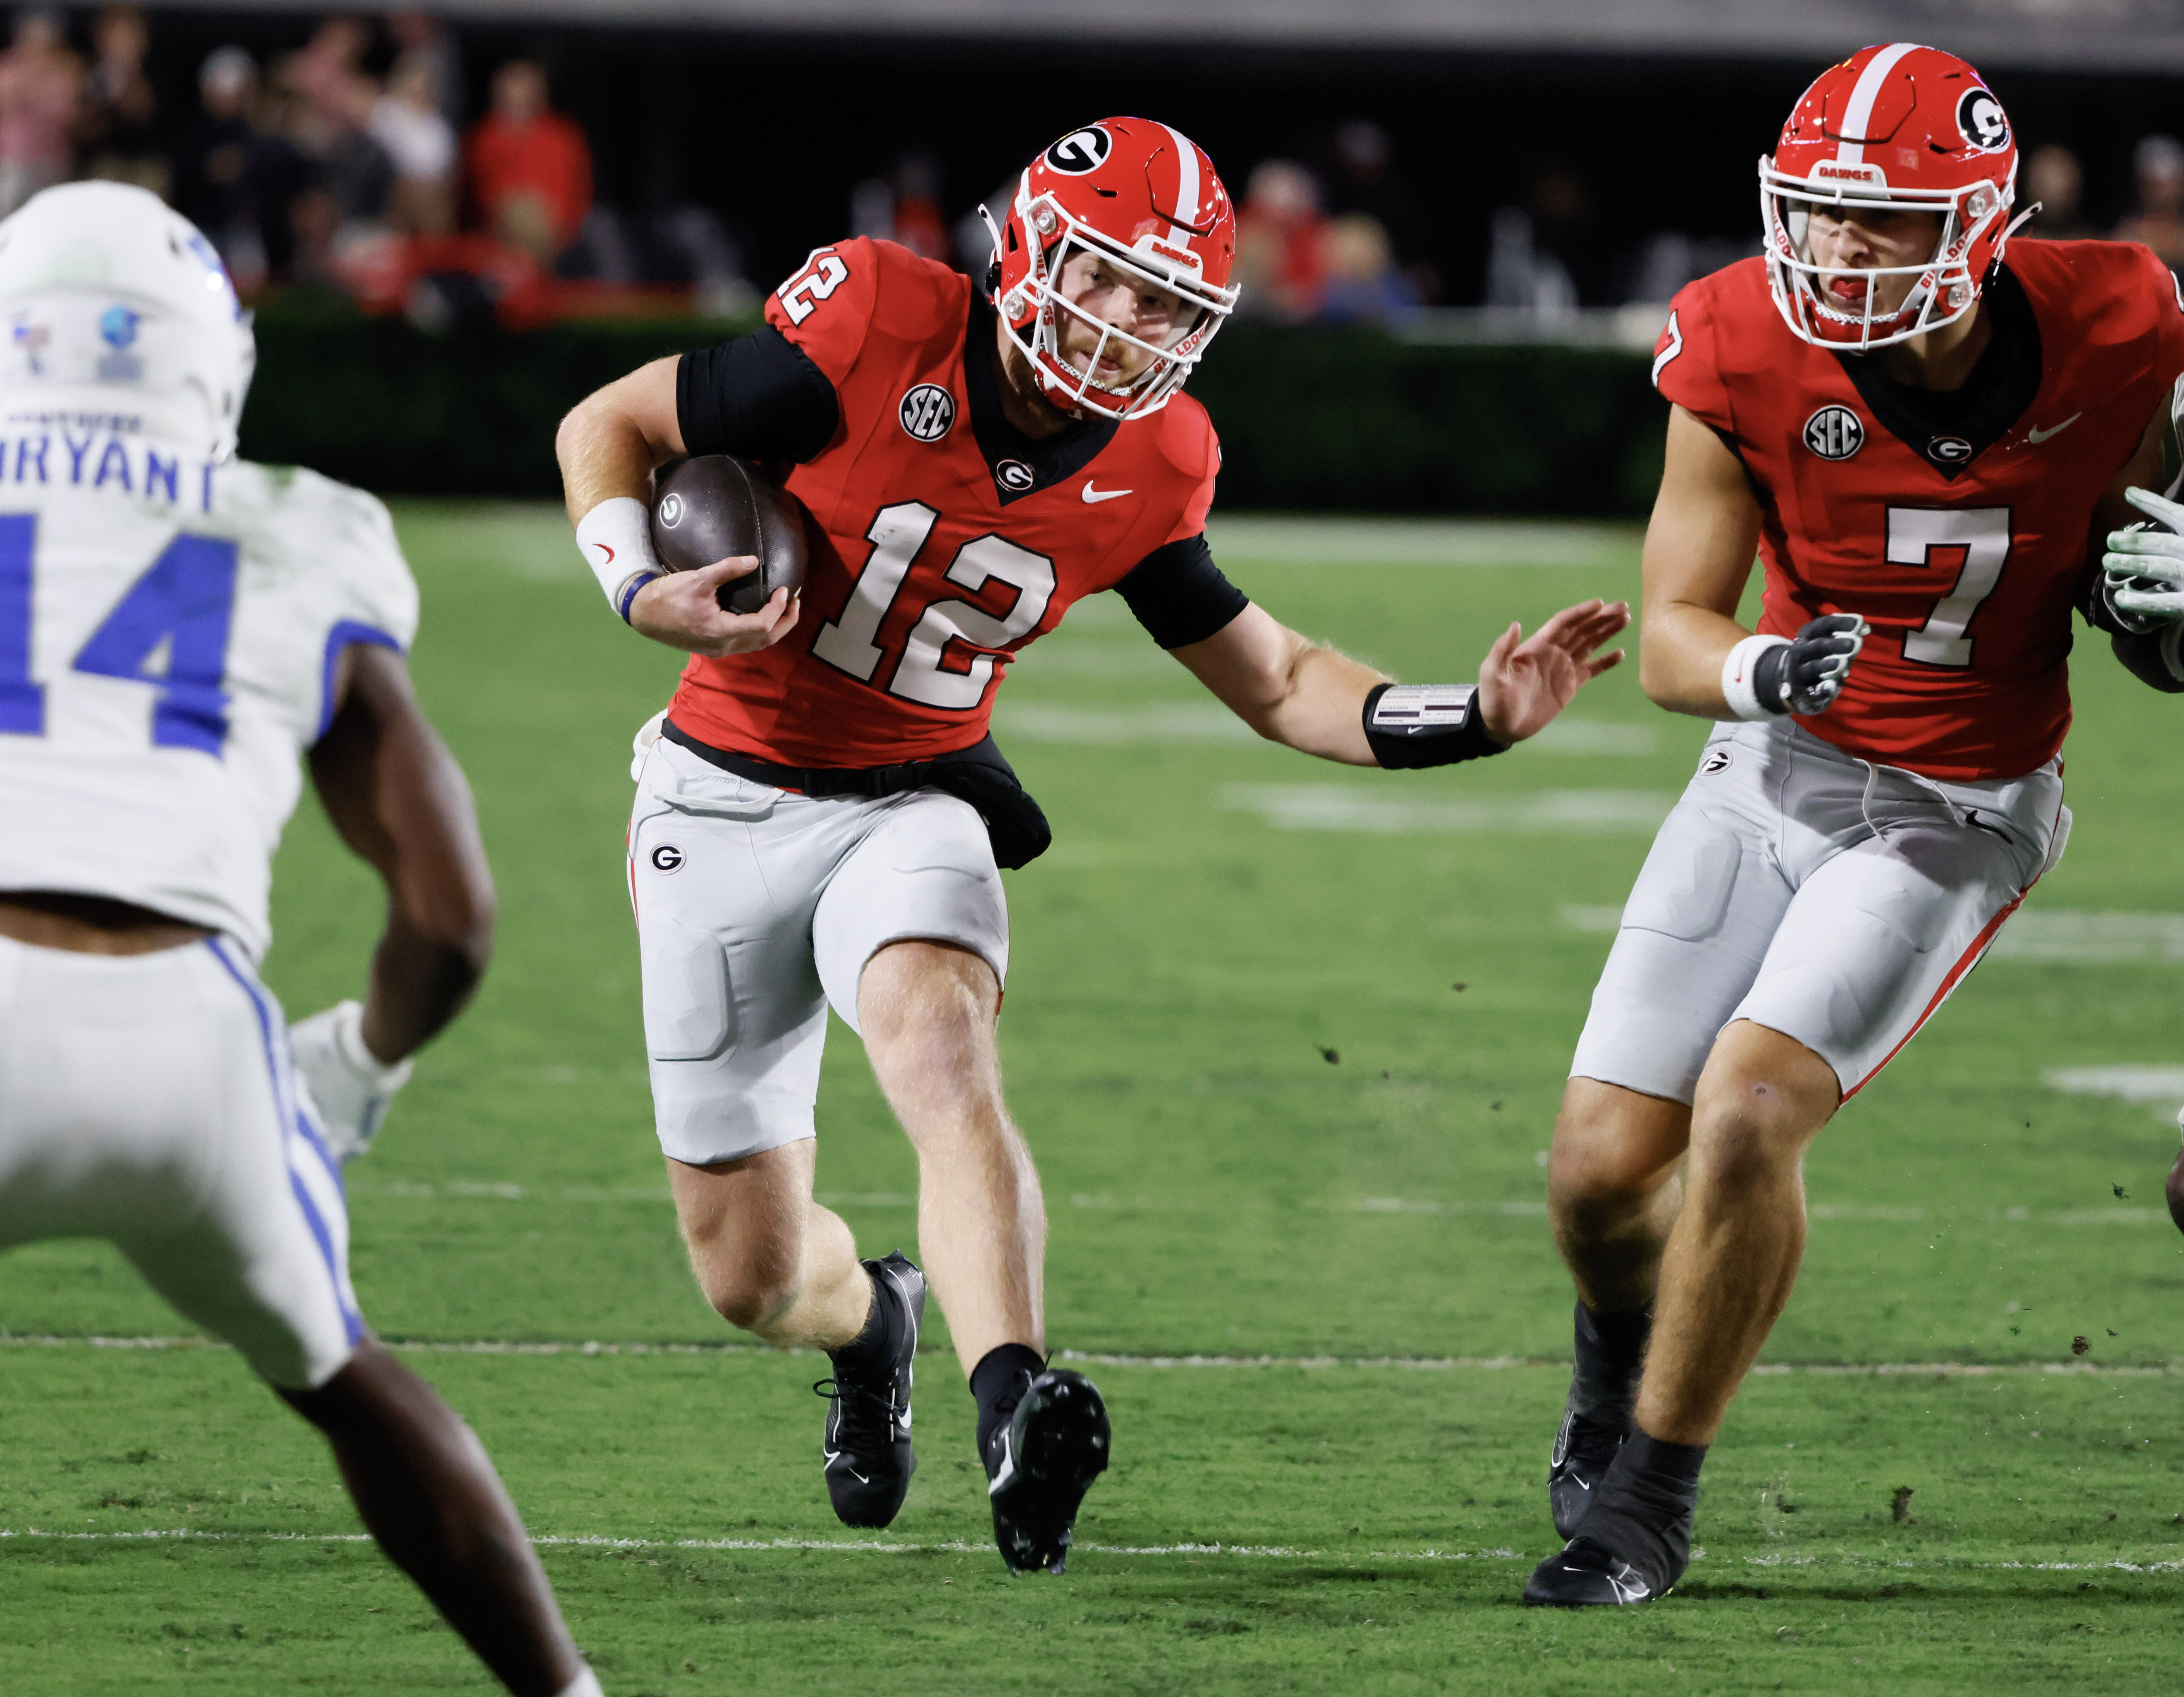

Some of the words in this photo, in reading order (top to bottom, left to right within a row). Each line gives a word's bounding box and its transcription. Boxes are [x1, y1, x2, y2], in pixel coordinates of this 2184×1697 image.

[1959, 90, 2009, 148] G
[1047, 127, 1109, 172] G
[1819, 167, 1872, 181] DAWGS
[1151, 241, 1199, 268] DAWGS
[1652, 309, 1683, 388] 7
[904, 388, 951, 438] SEC
[1810, 410, 1857, 456] SEC
[1928, 438, 1971, 460] G
[998, 461, 1032, 489] G
[809, 499, 1058, 710] 12
[1885, 505, 2014, 670] 7
[1701, 752, 1729, 772] G
[652, 846, 682, 870] G
